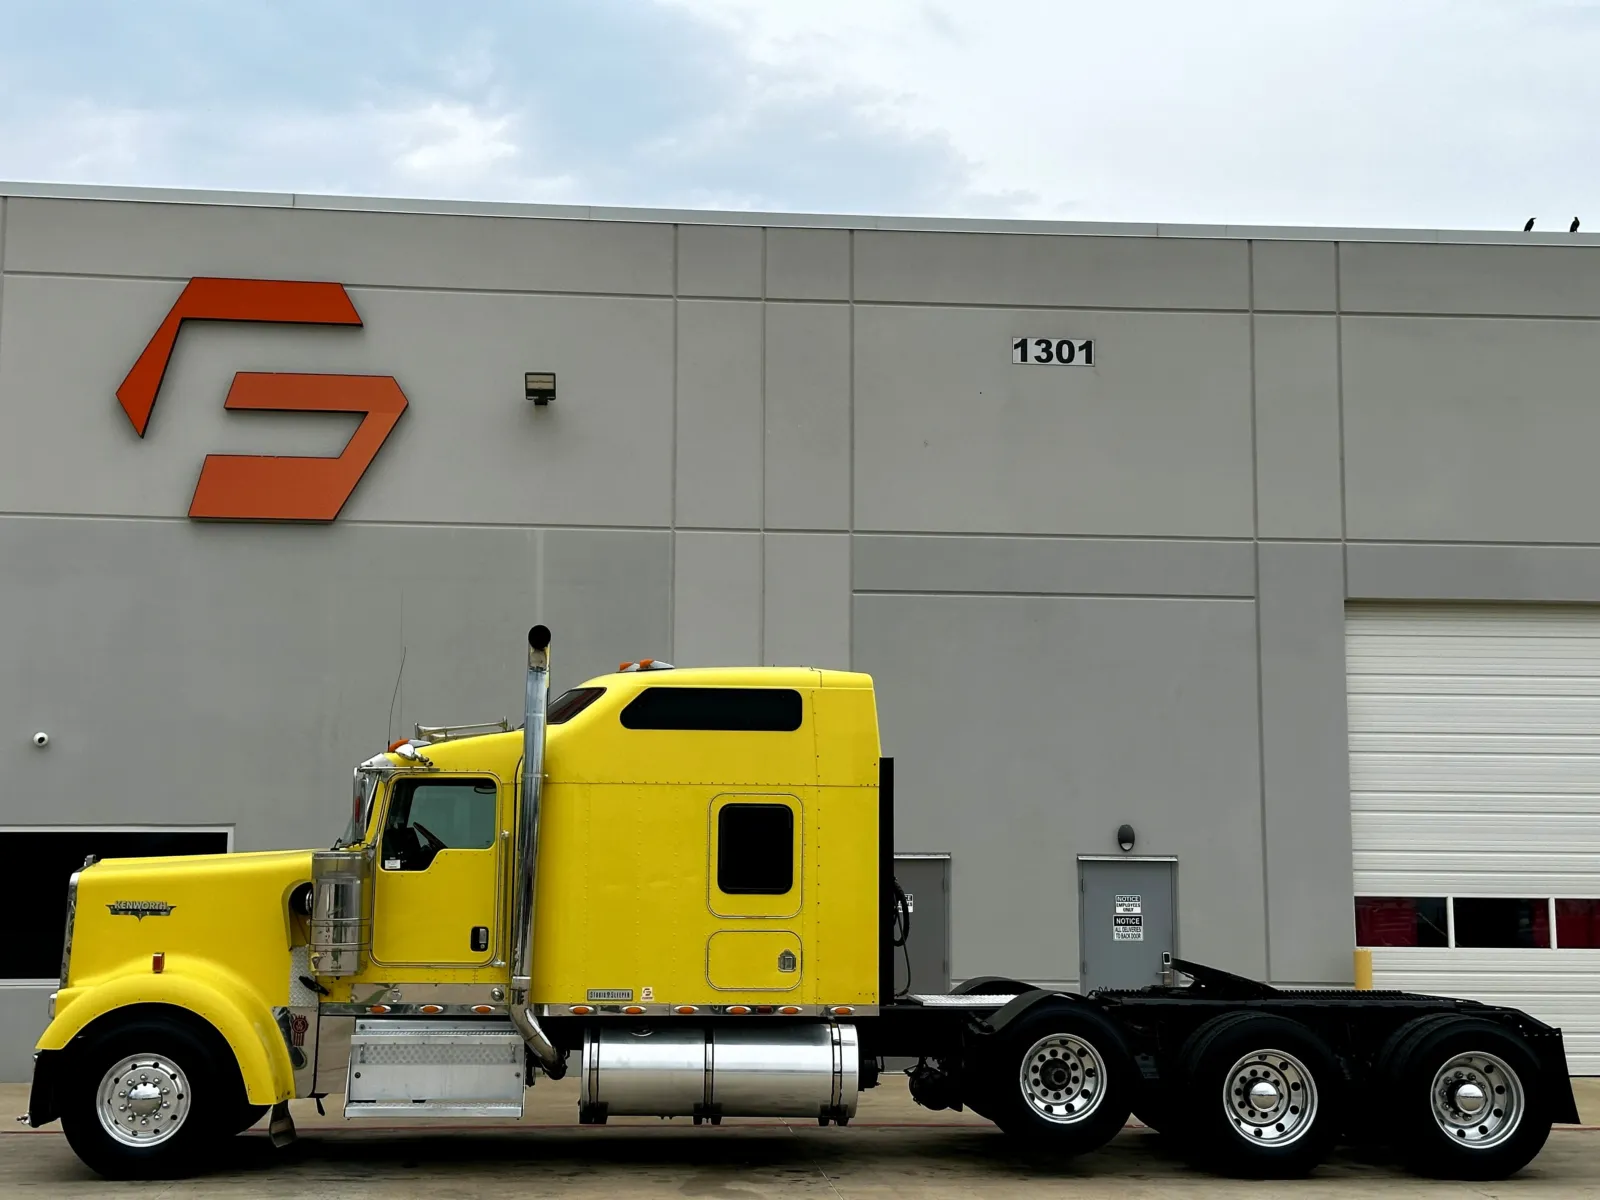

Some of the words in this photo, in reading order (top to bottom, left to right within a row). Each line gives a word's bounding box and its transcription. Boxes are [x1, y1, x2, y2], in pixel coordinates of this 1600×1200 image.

[1013, 338, 1093, 365] 1301
[115, 900, 168, 910] KENWORTH
[1116, 917, 1140, 925] NOTICE
